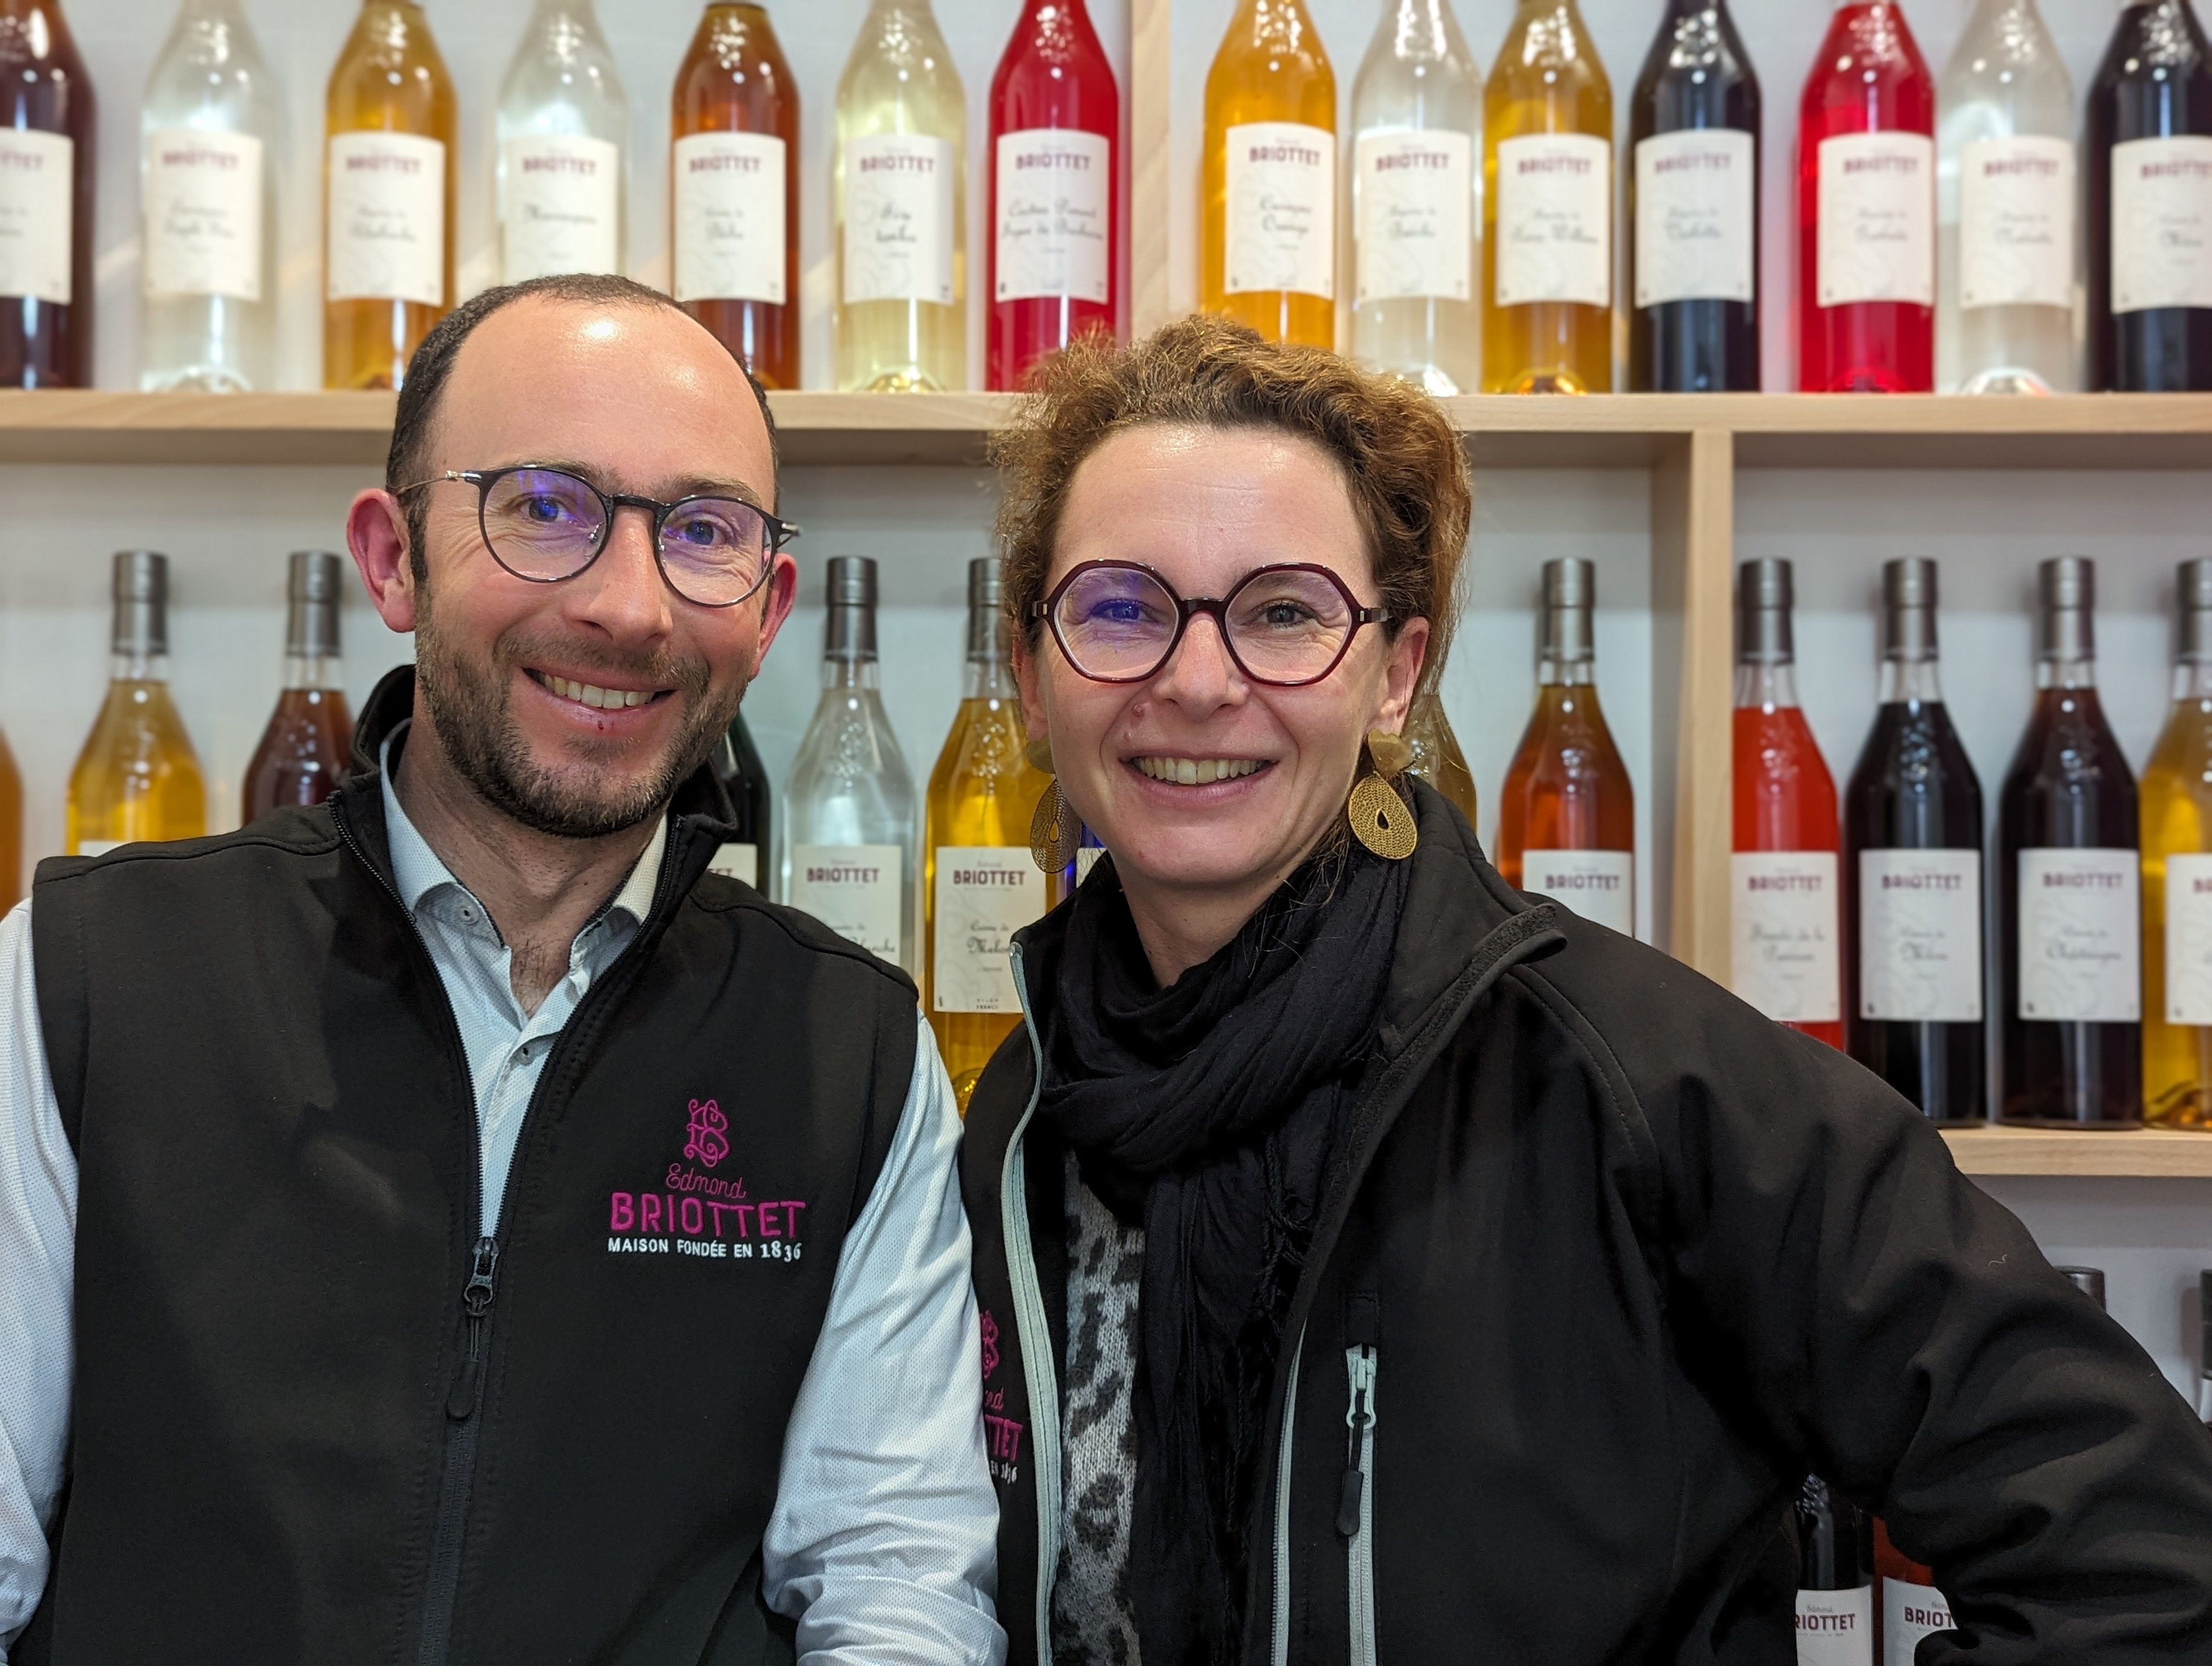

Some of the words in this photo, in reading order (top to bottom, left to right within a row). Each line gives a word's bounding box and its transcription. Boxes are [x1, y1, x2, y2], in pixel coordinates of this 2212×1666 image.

[1016, 153, 1091, 170] BRIOTTET
[1249, 146, 1320, 165] BRIOTTET
[1375, 153, 1449, 171] BRIOTTET
[807, 868, 879, 883] BRIOTTET
[954, 870, 1025, 886] BRIOTTET
[1545, 875, 1619, 890] BRIOTTET
[1748, 876, 1822, 892] BRIOTTET
[1881, 875, 1961, 890] BRIOTTET
[2043, 874, 2122, 888] BRIOTTET
[666, 1163, 746, 1199] Edmond
[610, 1191, 806, 1239] BRIOTTET
[608, 1238, 669, 1253] MAISON
[677, 1240, 726, 1258] FONDÉE
[734, 1244, 753, 1258] EN
[760, 1240, 802, 1263] 1836
[1794, 1613, 1855, 1630] RIOTTET
[1904, 1606, 1952, 1628] BRIOT
